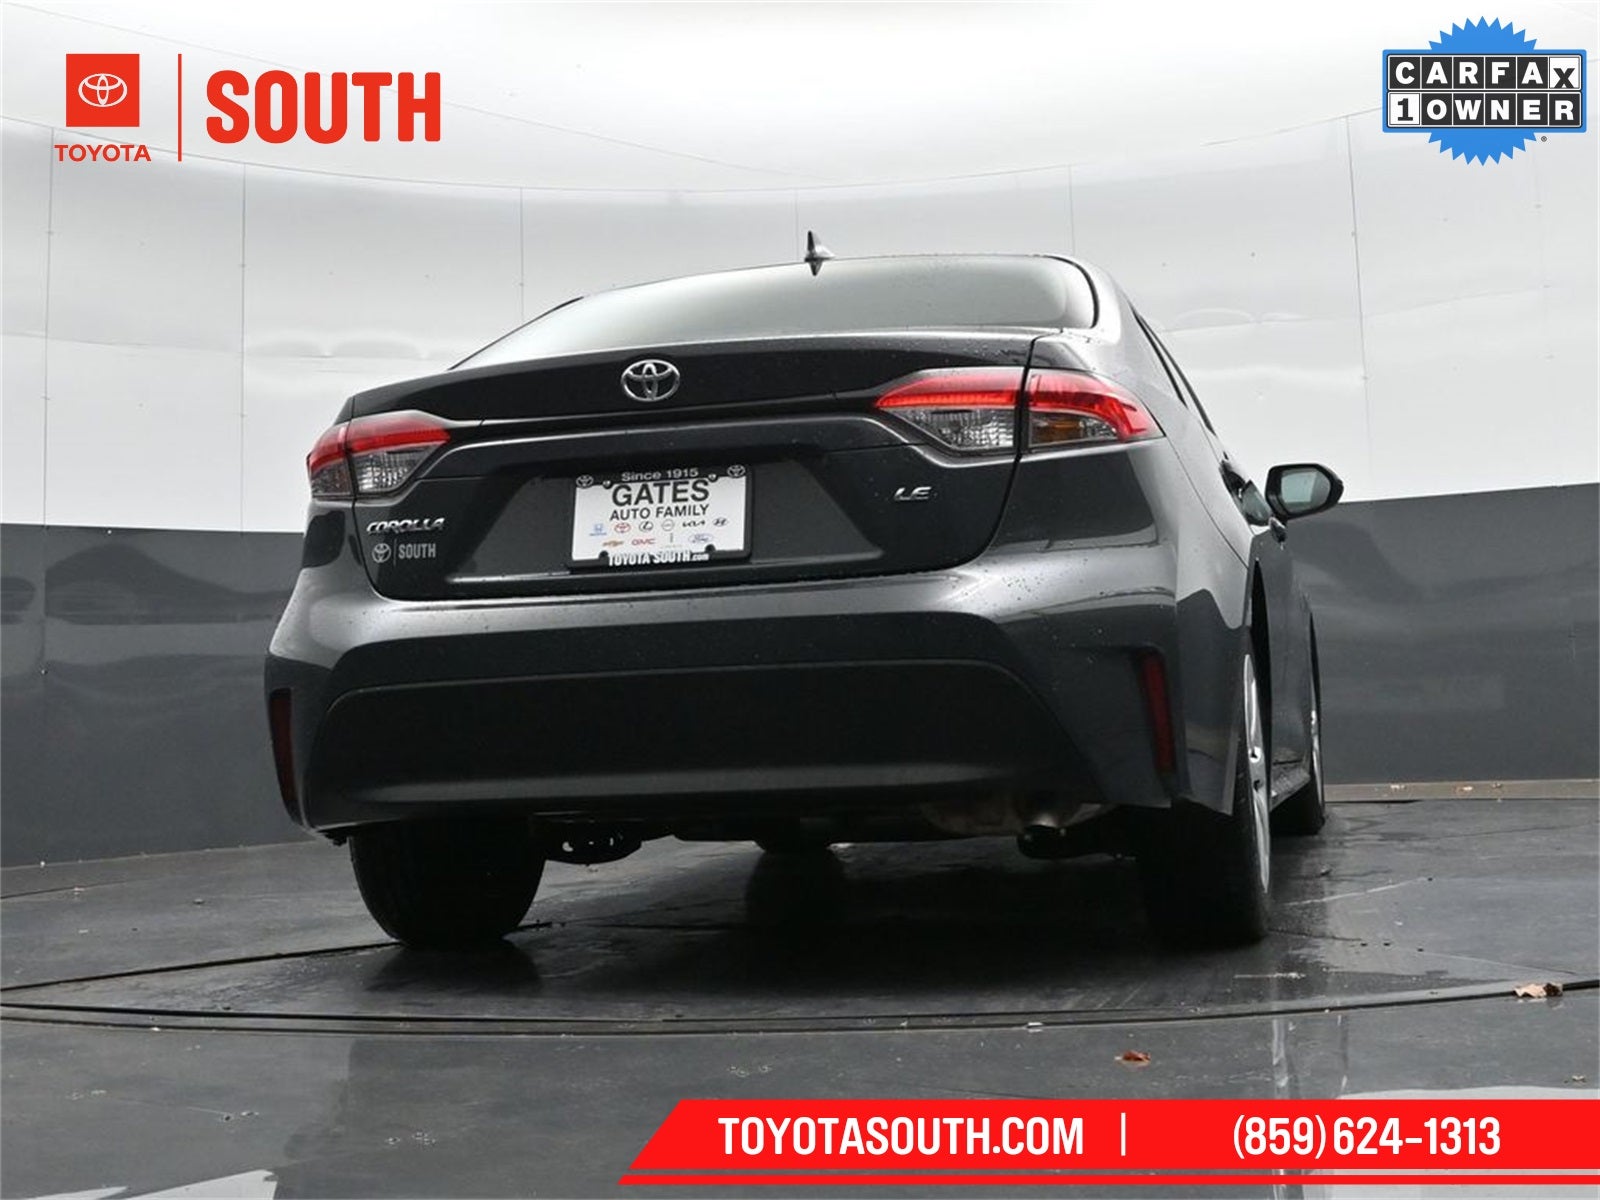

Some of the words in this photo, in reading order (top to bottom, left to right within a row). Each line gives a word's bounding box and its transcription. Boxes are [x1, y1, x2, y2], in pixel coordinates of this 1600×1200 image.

[621, 471, 662, 482] Since
[666, 468, 699, 479] 1915
[612, 479, 710, 507] GATES
[894, 486, 932, 501] LE
[609, 507, 651, 521] AUTO
[655, 504, 710, 518] FAMILY
[366, 518, 445, 535] COROLLA
[631, 538, 655, 546] GMC
[398, 543, 436, 559] SOUTH
[608, 552, 651, 567] TOYOTA
